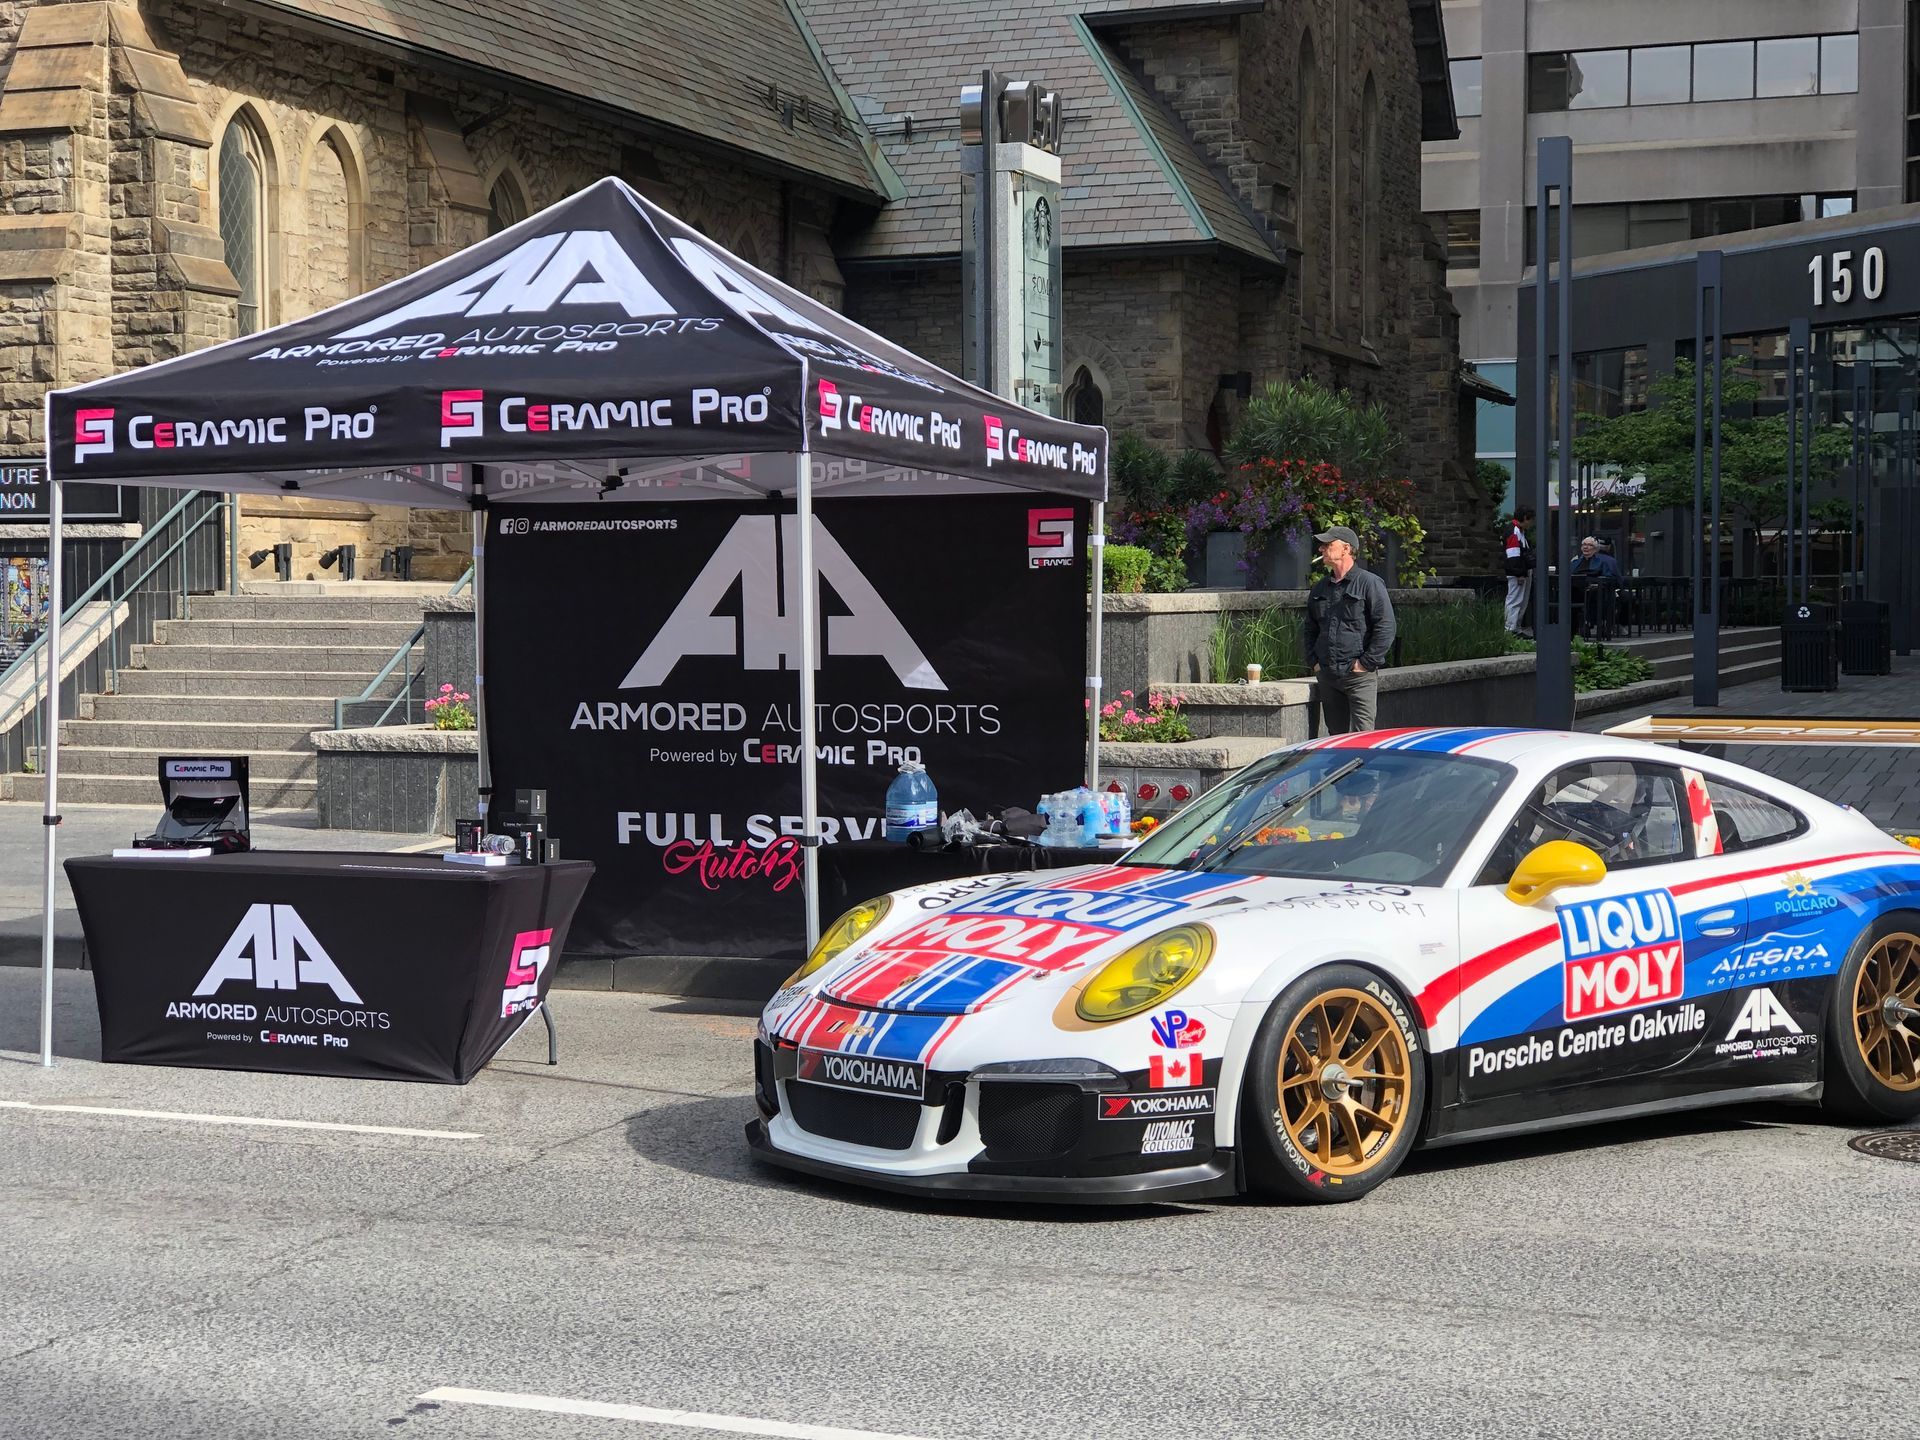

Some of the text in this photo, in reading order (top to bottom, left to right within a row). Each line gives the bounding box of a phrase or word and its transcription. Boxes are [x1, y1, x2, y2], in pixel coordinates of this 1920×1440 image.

[1808, 247, 1885, 306] 150
[249, 318, 724, 360] ARMORED AUTOSPORTS
[316, 356, 387, 368] Powered
[393, 354, 413, 364] by
[129, 414, 287, 449] CERAMIC
[500, 397, 672, 432] CERAMIC
[848, 396, 923, 442] CERAMIC
[1008, 430, 1067, 469] CERAMIC
[0, 492, 36, 509] NON
[532, 519, 678, 532] #ARMOREDAUTOSPORTS
[570, 702, 1001, 734] ARMORED AUTOSPORTS
[650, 748, 714, 763] Powered
[719, 748, 737, 766] by
[617, 811, 733, 847] FULL
[956, 891, 1179, 928] LIQUI
[1775, 896, 1838, 914] POLICARO
[890, 917, 1113, 962] MOLY
[1562, 890, 1676, 957] LIQUI
[1707, 961, 1832, 986] MOTORSPORTS
[1711, 943, 1829, 974] ALEGRA
[1571, 944, 1680, 1013] MOLY
[165, 1001, 390, 1030] ARMORED AUTOSPORTS
[1150, 1010, 1187, 1049] VP
[1365, 980, 1417, 1053] ADVAN
[206, 1032, 240, 1042] Powered
[242, 1032, 253, 1044] by
[1469, 1003, 1706, 1077] Porsche Centre Oakville
[1715, 1034, 1817, 1054] ARMORED AUTOSPORTS
[824, 1055, 919, 1091] YOKOHAMA
[1131, 1095, 1209, 1114] YOKOHAMA
[1142, 1119, 1195, 1141] AUTOMACS
[1143, 1139, 1192, 1152] COLLISION
[1272, 1108, 1311, 1175] YOKOHAMA
